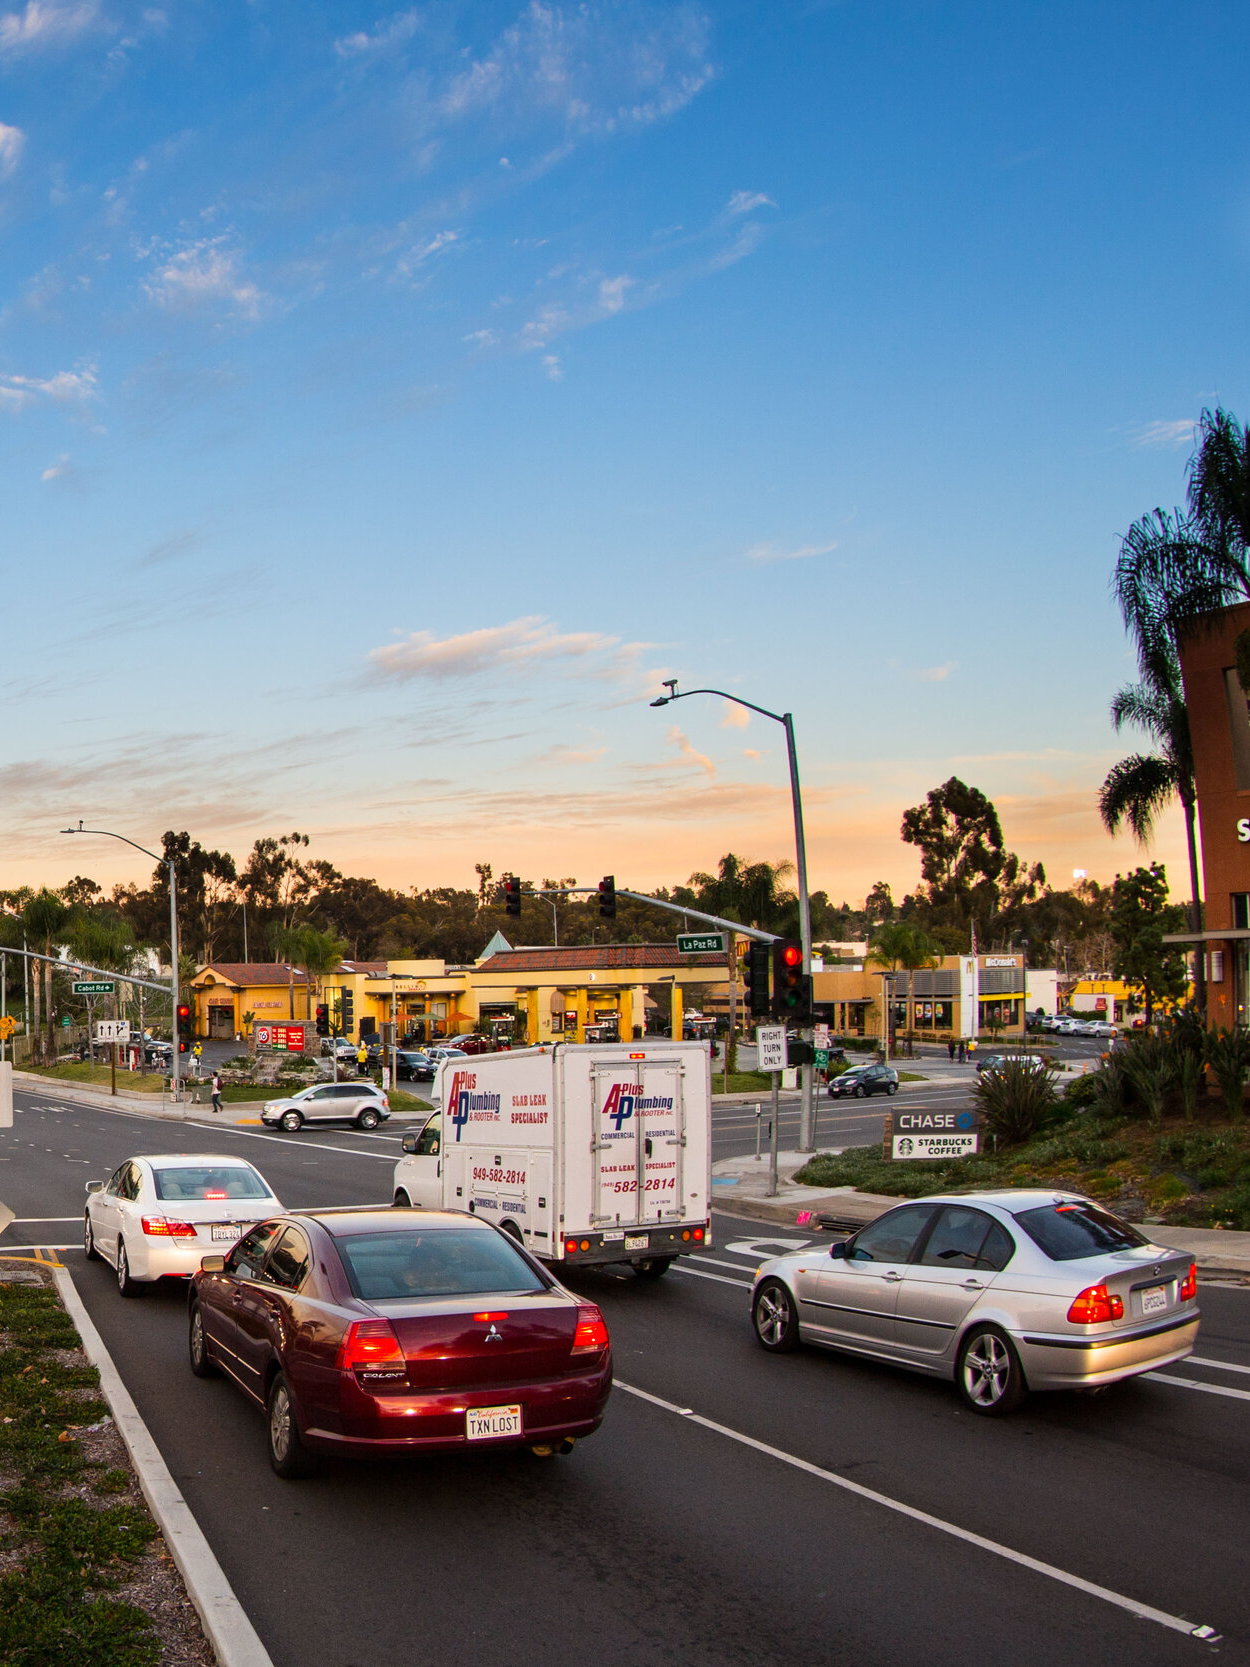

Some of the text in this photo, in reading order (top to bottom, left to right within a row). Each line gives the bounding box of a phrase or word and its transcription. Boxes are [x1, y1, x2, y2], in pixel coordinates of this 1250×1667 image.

[683, 939, 718, 950] La Paz Rd
[761, 1031, 782, 1041] RIGHT
[763, 1044, 781, 1053] TURN
[764, 1056, 781, 1066] ONLY
[460, 1071, 477, 1090] Plus
[621, 1083, 644, 1095] Plus
[512, 1094, 547, 1106] SLAB LEAK
[473, 1112, 494, 1121] ROOTER
[511, 1112, 548, 1124] SPECIALIST
[899, 1114, 955, 1128] CHASE
[601, 1129, 676, 1140] COMMERCIAL RESIDENTIAL
[918, 1138, 973, 1147] STARBUCKS
[928, 1147, 962, 1155] COFFEE
[618, 1164, 636, 1172] LEAK
[645, 1161, 676, 1170] SPECIALIST
[472, 1167, 526, 1185] 949-582-2814
[614, 1177, 676, 1193] 582-2814
[474, 1197, 527, 1214] COMMERCIAL RESIDENTIAL
[478, 1409, 510, 1419] California
[470, 1416, 518, 1435] TXN LOST
